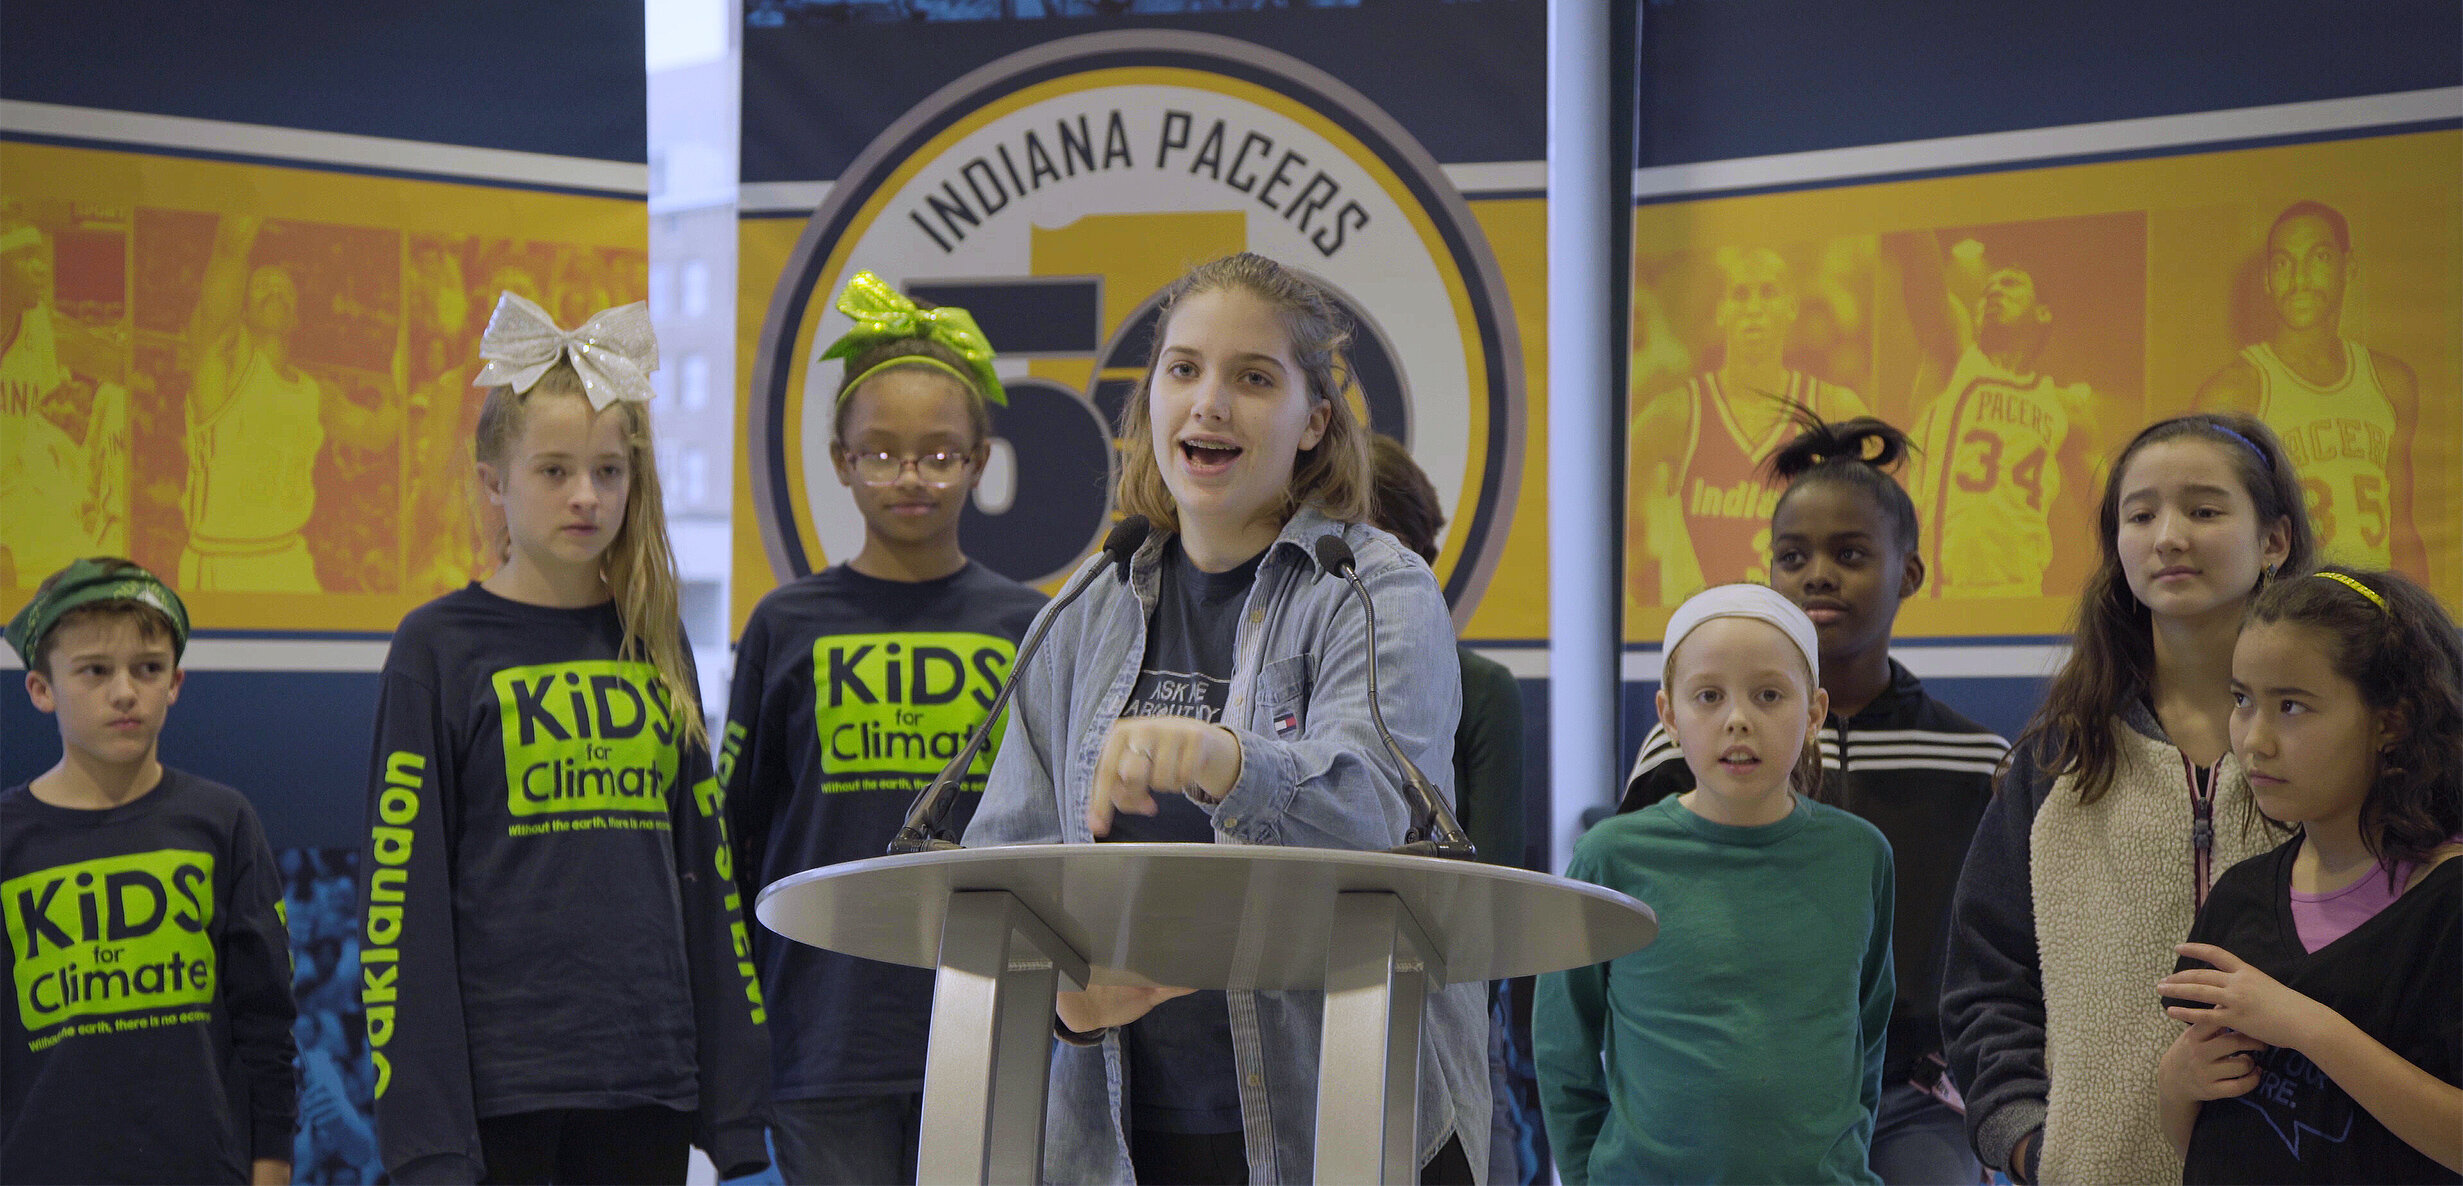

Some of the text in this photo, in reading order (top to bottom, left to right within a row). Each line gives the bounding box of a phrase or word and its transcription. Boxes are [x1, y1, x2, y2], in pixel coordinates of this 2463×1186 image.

[909, 108, 1371, 257] INDIANA PACERS
[2282, 417, 2387, 471] ACER
[1956, 429, 2047, 513] 34
[1691, 477, 1782, 519] India
[828, 642, 1007, 710] KiDS
[1149, 680, 1190, 702] ASK
[511, 672, 675, 746] KiDS
[896, 709, 924, 726] for
[586, 743, 612, 761] for
[522, 758, 663, 803] Climat
[861, 779, 878, 791] the
[508, 821, 550, 837] Without
[551, 818, 571, 832] the
[571, 816, 607, 831] earth,
[638, 819, 654, 830] no
[17, 864, 206, 960] KiDS
[93, 946, 125, 964] for
[29, 952, 208, 1014] Climate
[78, 1020, 112, 1036] earth,
[114, 1017, 149, 1032] there
[149, 1014, 160, 1027] is
[161, 1013, 178, 1026] no
